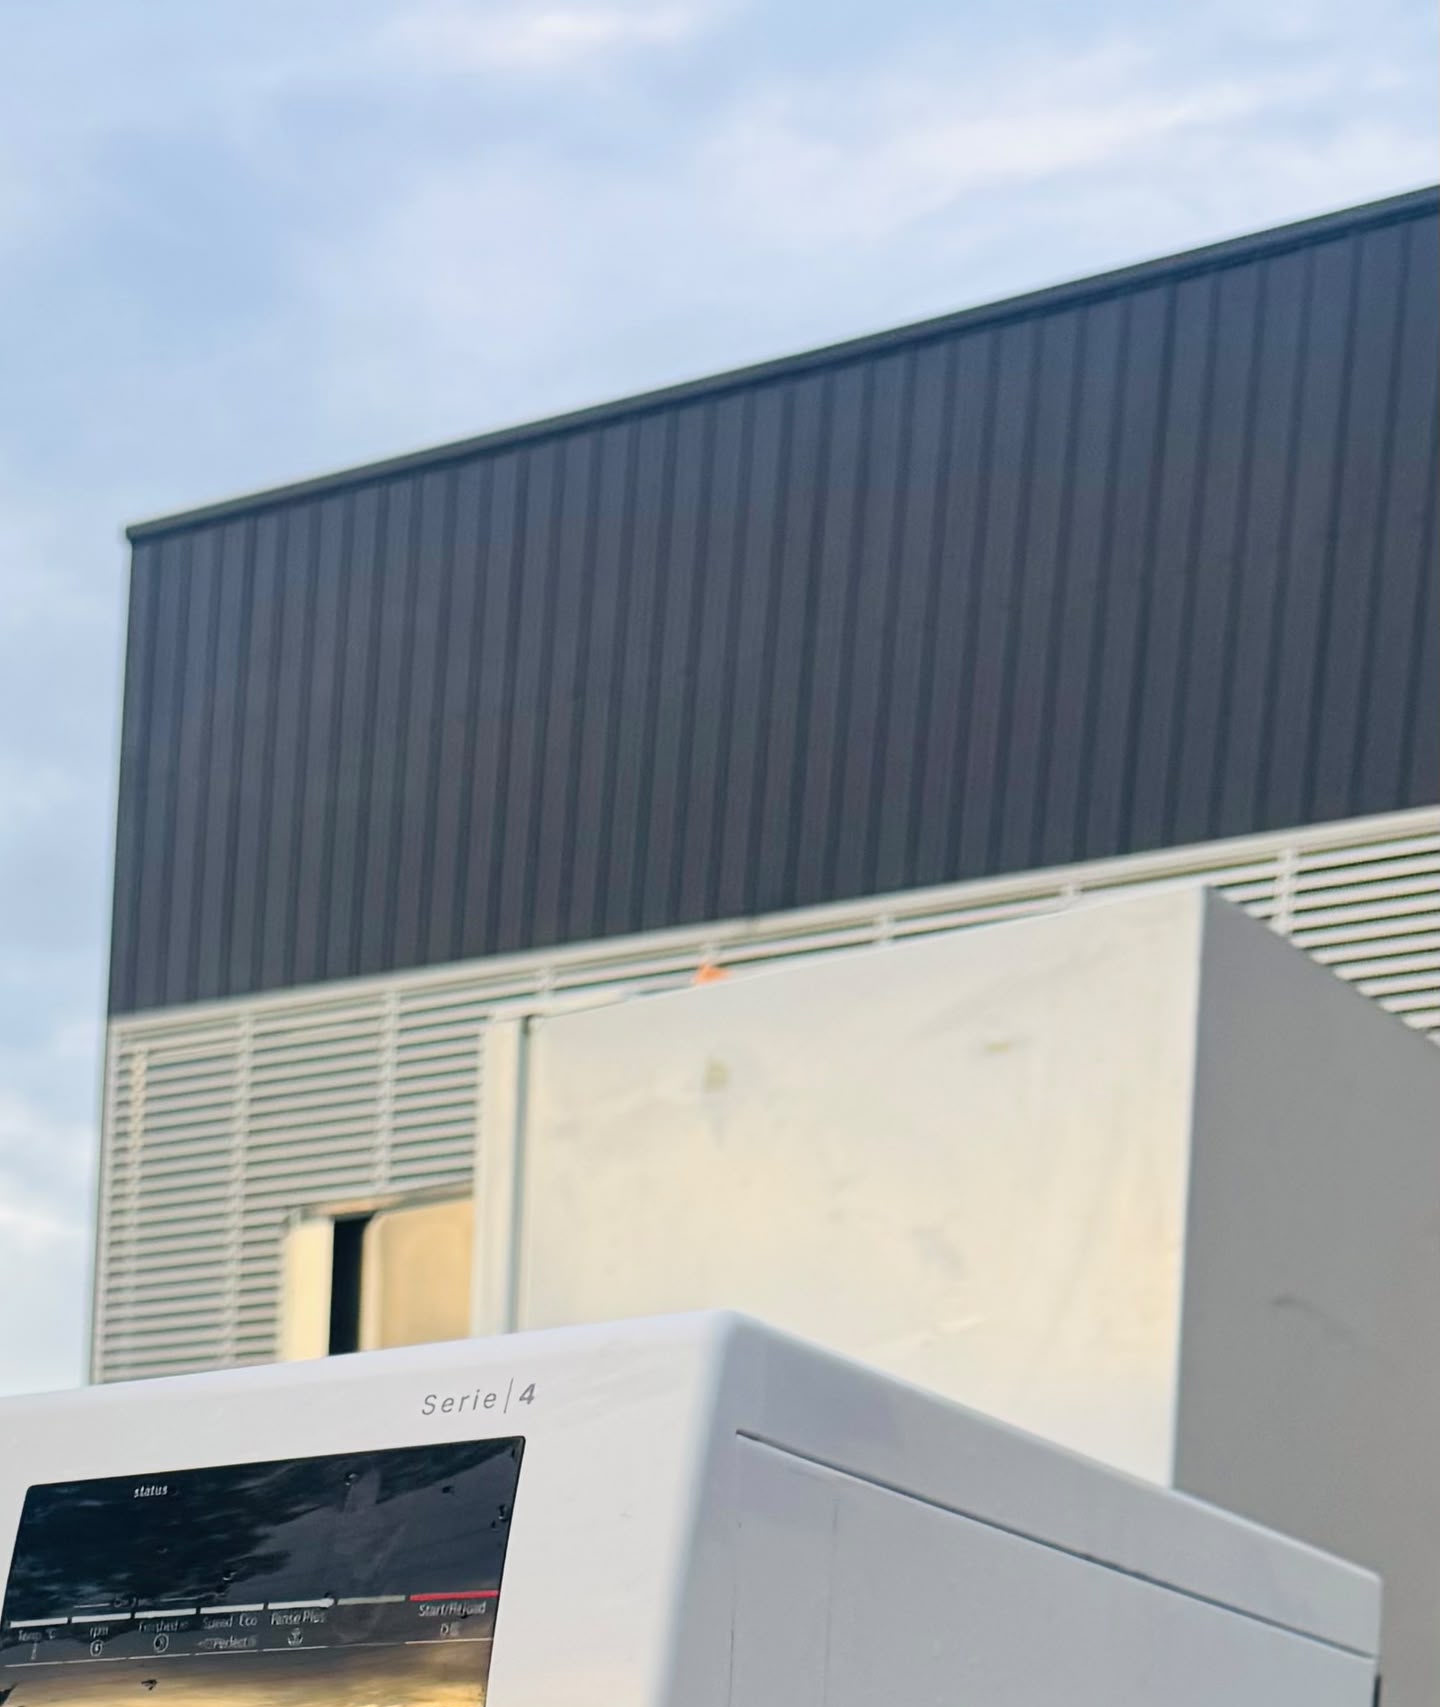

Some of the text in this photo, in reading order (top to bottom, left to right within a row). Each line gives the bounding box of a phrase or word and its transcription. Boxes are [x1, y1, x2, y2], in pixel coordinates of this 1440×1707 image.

[422, 1388, 497, 1415] Serie
[519, 1383, 536, 1405] 4
[134, 1484, 168, 1498] status
